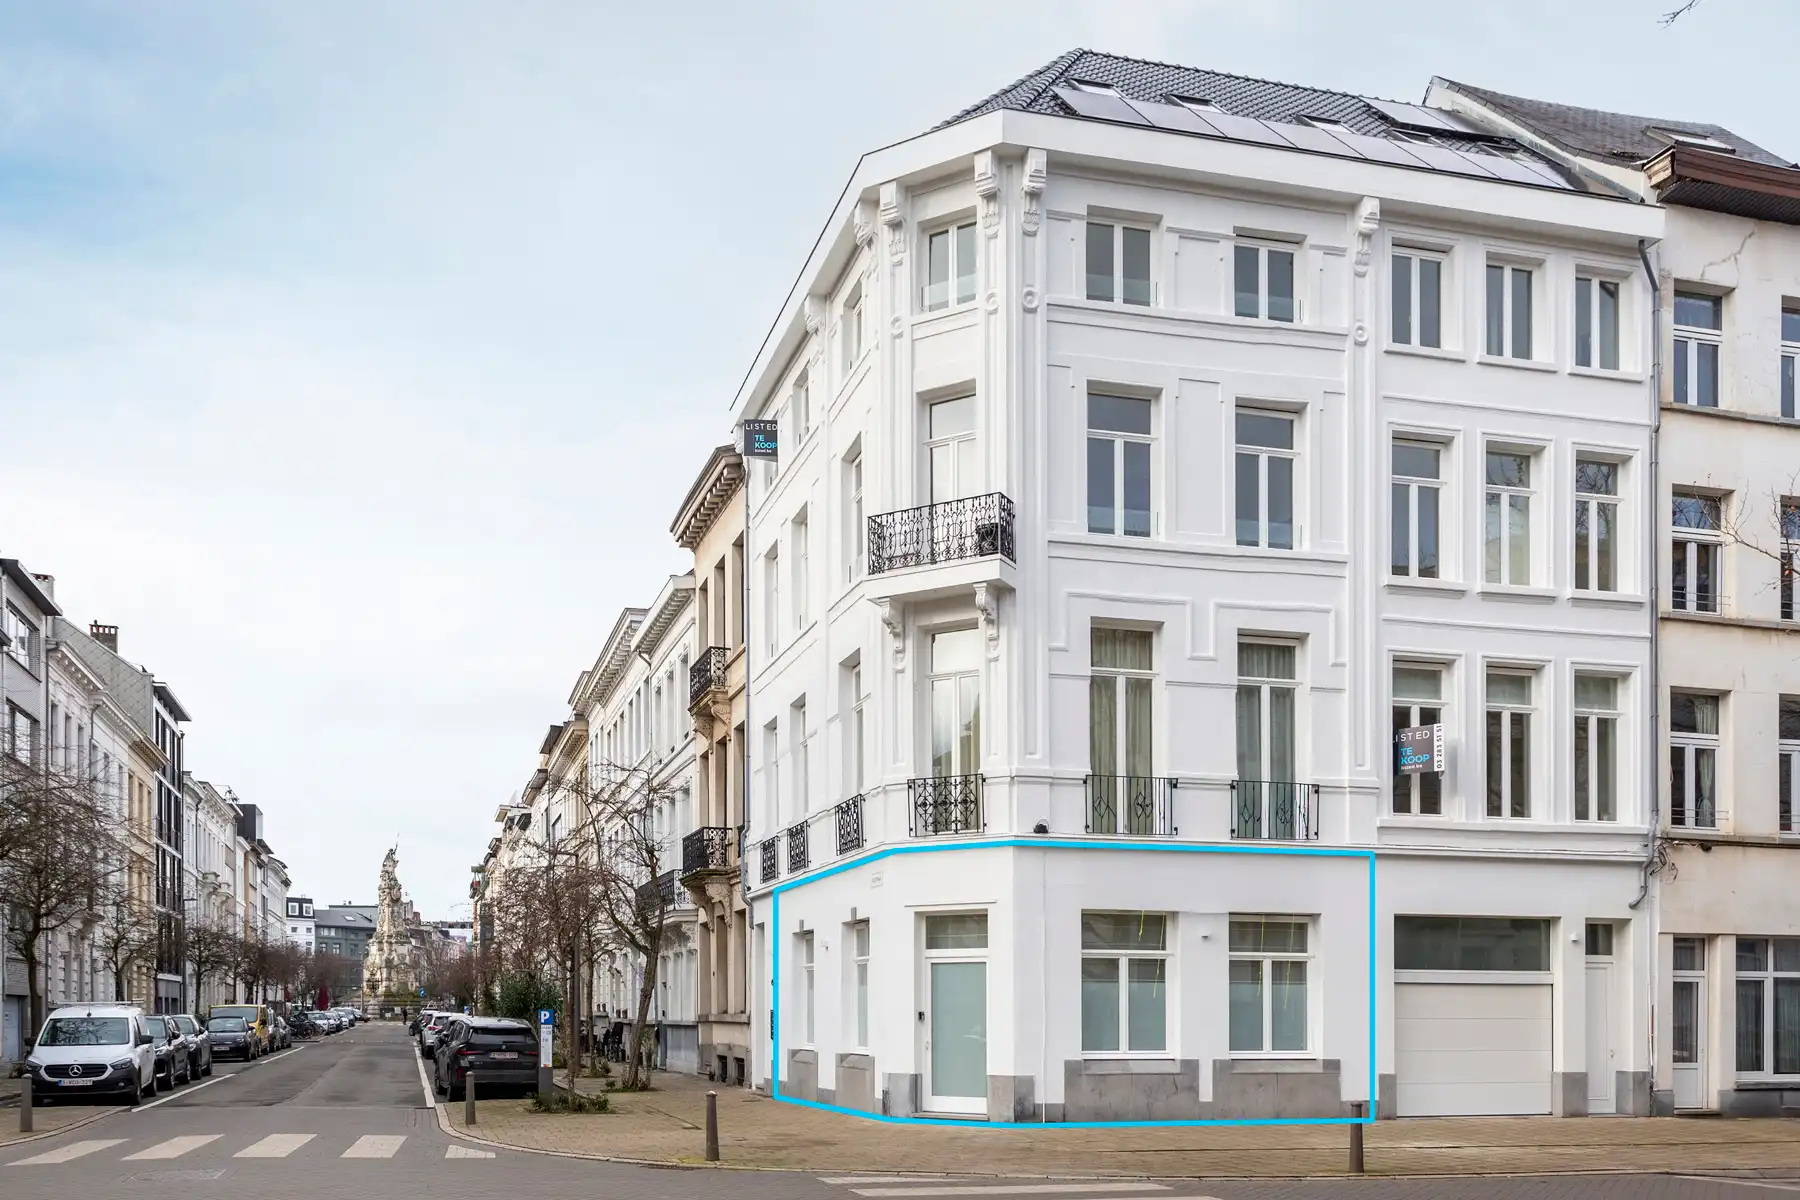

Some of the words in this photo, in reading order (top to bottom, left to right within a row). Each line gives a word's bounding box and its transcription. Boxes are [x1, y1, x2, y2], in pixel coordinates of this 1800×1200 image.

[1393, 730, 1430, 743] ISTED
[1400, 746, 1413, 756] TE
[1400, 753, 1431, 765] KOOP
[1436, 759, 1443, 769] 03
[541, 1011, 549, 1023] P
